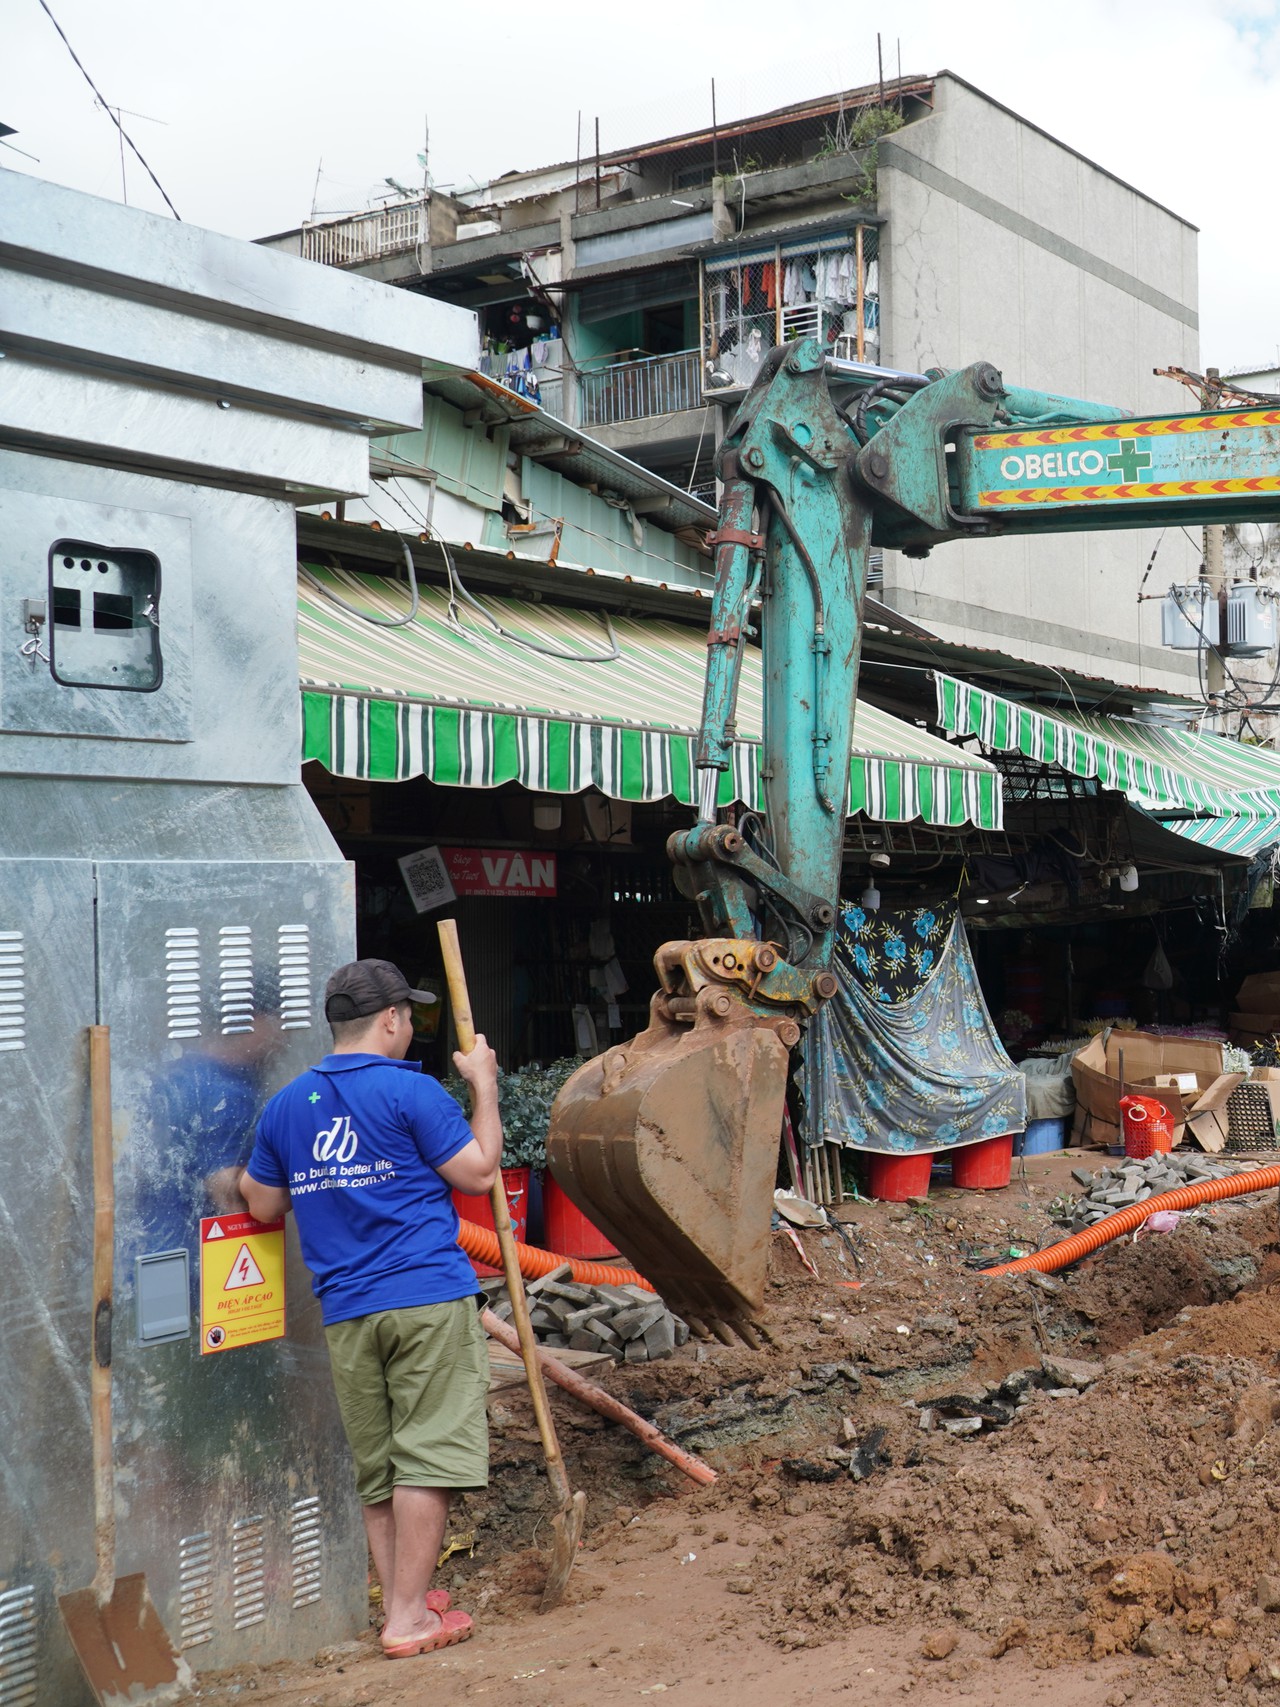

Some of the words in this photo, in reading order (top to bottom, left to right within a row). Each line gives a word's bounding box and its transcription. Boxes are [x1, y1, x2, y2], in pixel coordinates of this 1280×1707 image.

[1000, 449, 1104, 481] OBELCO
[481, 852, 555, 888] VÂN
[312, 1115, 358, 1163] db
[329, 1165, 337, 1176] a
[340, 1163, 371, 1176] better
[375, 1159, 393, 1172] life
[217, 1298, 239, 1310] ĐIỆN
[255, 1291, 273, 1303] CAO
